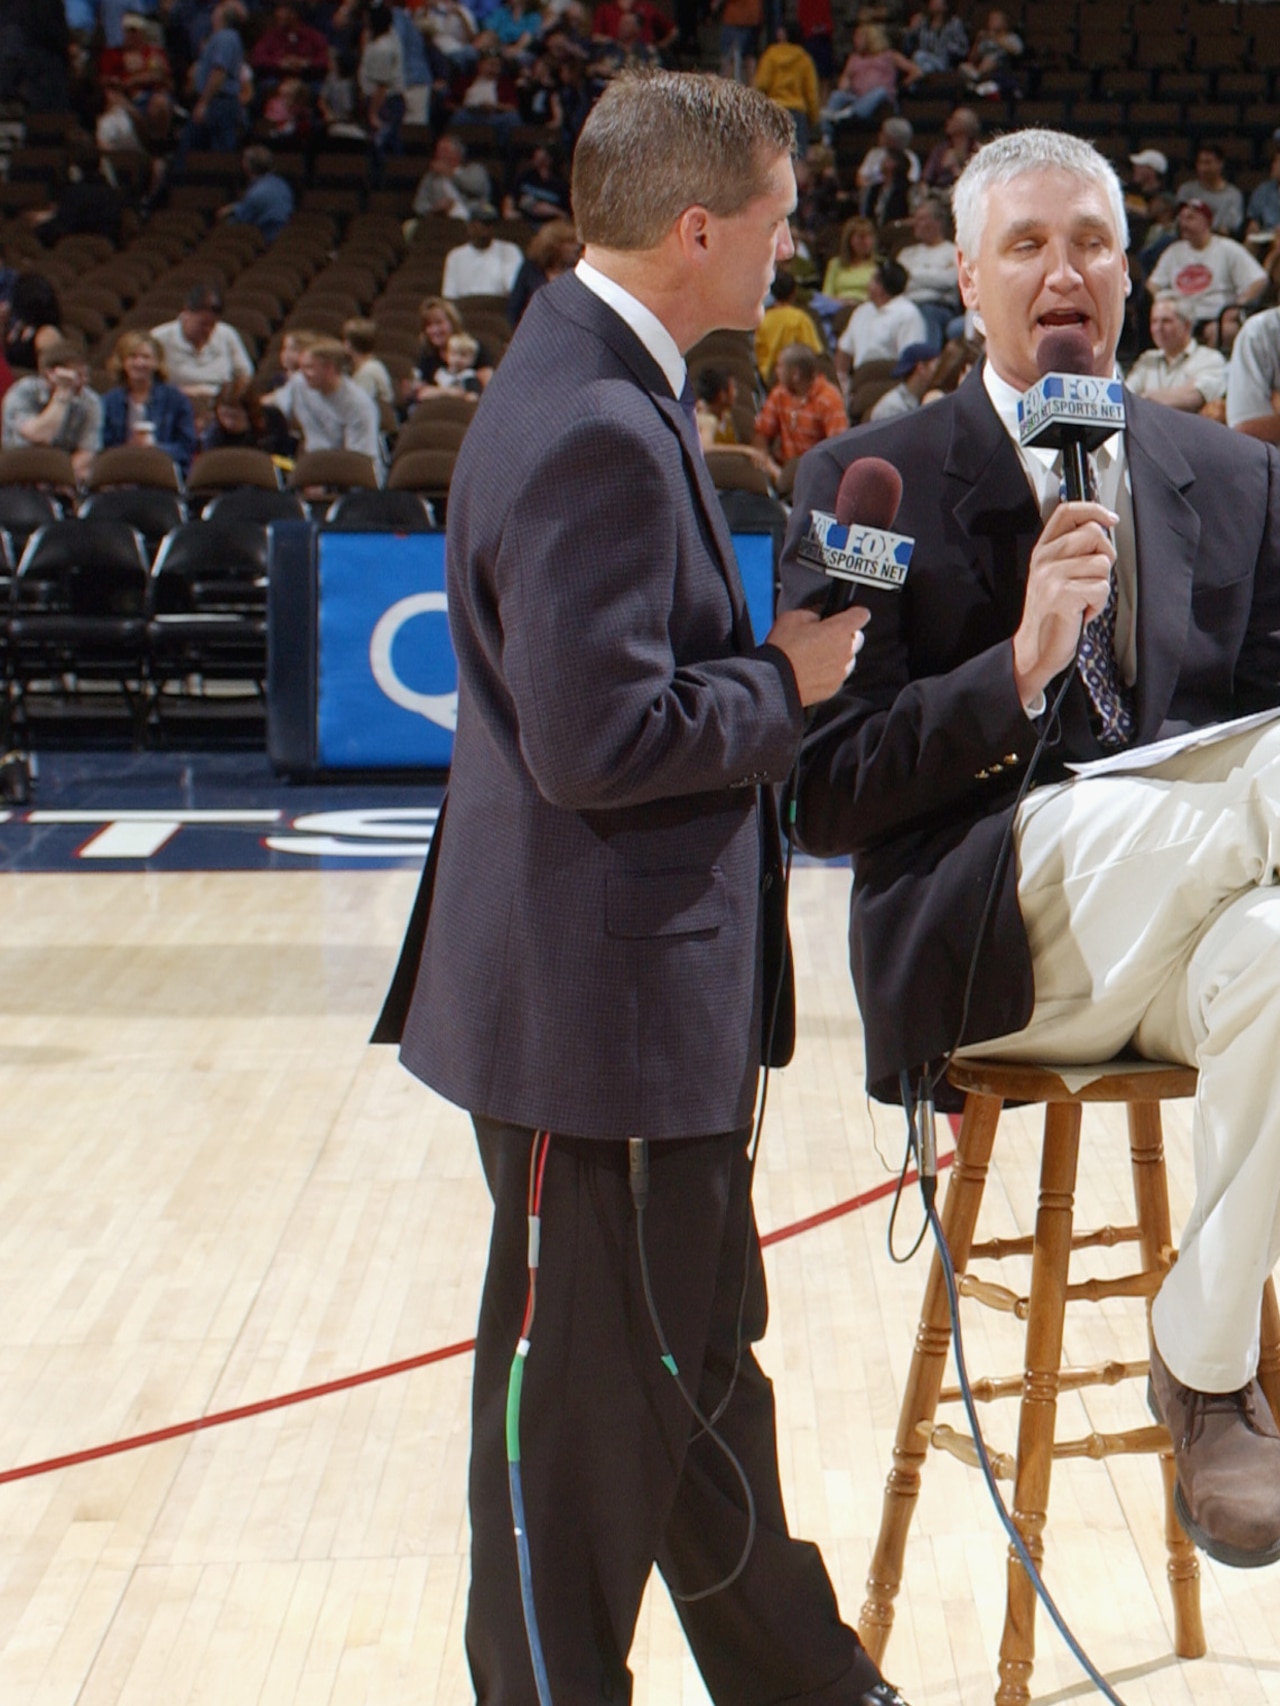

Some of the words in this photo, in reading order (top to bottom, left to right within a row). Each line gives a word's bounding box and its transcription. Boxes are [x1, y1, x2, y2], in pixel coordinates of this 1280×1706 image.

[1065, 379, 1108, 403] FOX
[1052, 399, 1098, 416] SPORTS
[1101, 405, 1122, 419] NET
[850, 531, 896, 563] FOX
[829, 550, 878, 576] SPORTS
[880, 563, 906, 581] NET
